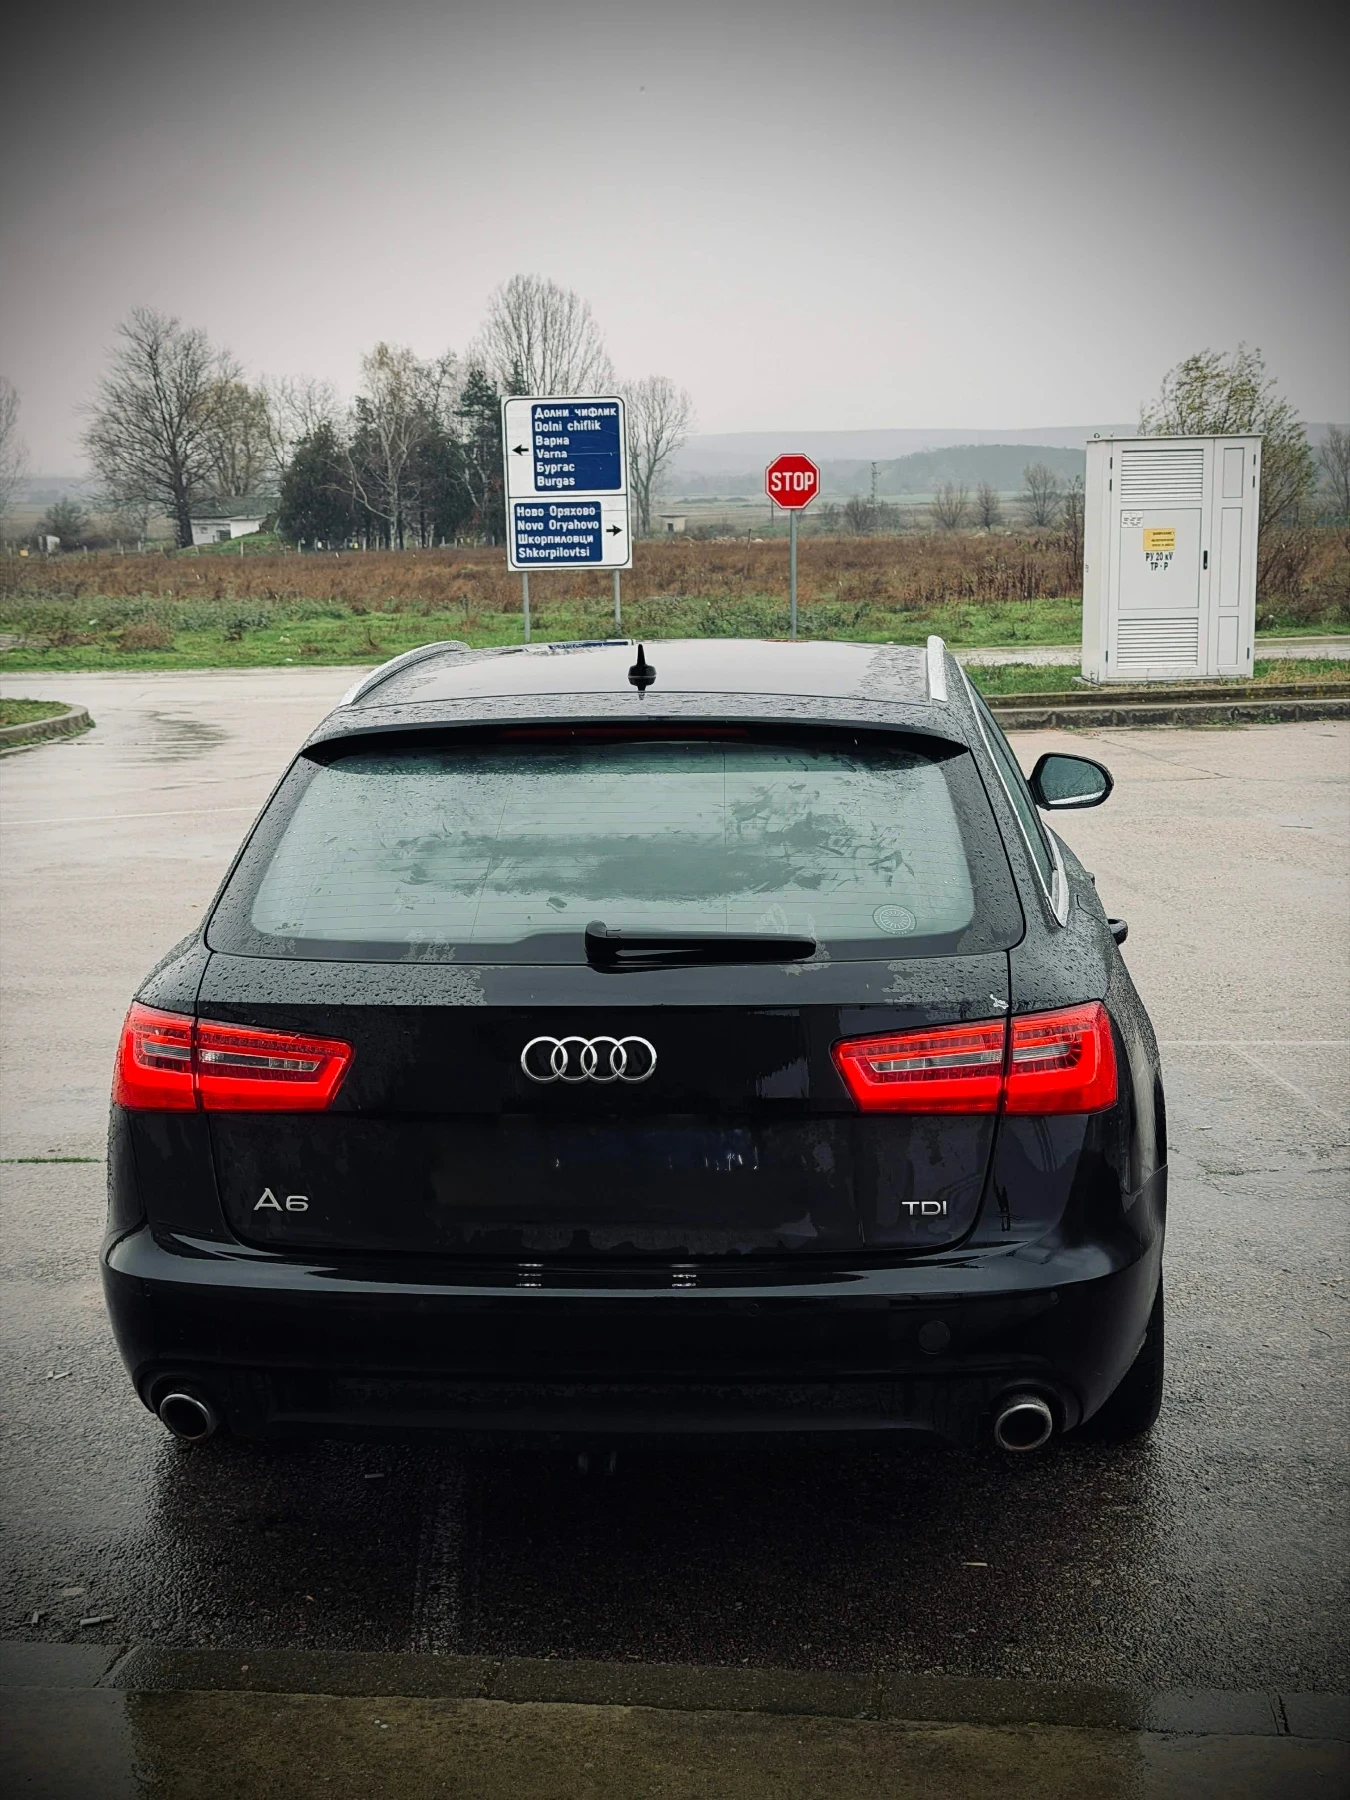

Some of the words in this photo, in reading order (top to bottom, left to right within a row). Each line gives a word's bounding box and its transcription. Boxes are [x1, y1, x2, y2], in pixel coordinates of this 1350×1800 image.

[534, 407, 569, 419] Долни
[574, 407, 617, 417] чифлик
[534, 421, 562, 432] Dolni
[567, 420, 601, 431] chiflik
[535, 435, 570, 447] Варна
[536, 449, 567, 458] Varna
[536, 462, 575, 475] Бургас
[537, 476, 575, 488] Burgas
[771, 471, 814, 491] STOP
[516, 506, 544, 517] Ново
[549, 505, 595, 518] Оряхово
[517, 520, 544, 530] Novo
[548, 519, 599, 532] Oryahovo
[517, 534, 593, 546] Шкорпиловци
[518, 546, 590, 559] Shkorpilovtsi
[1155, 552, 1163, 561] 20
[253, 1187, 309, 1211] A6
[901, 1200, 947, 1215] TDI
